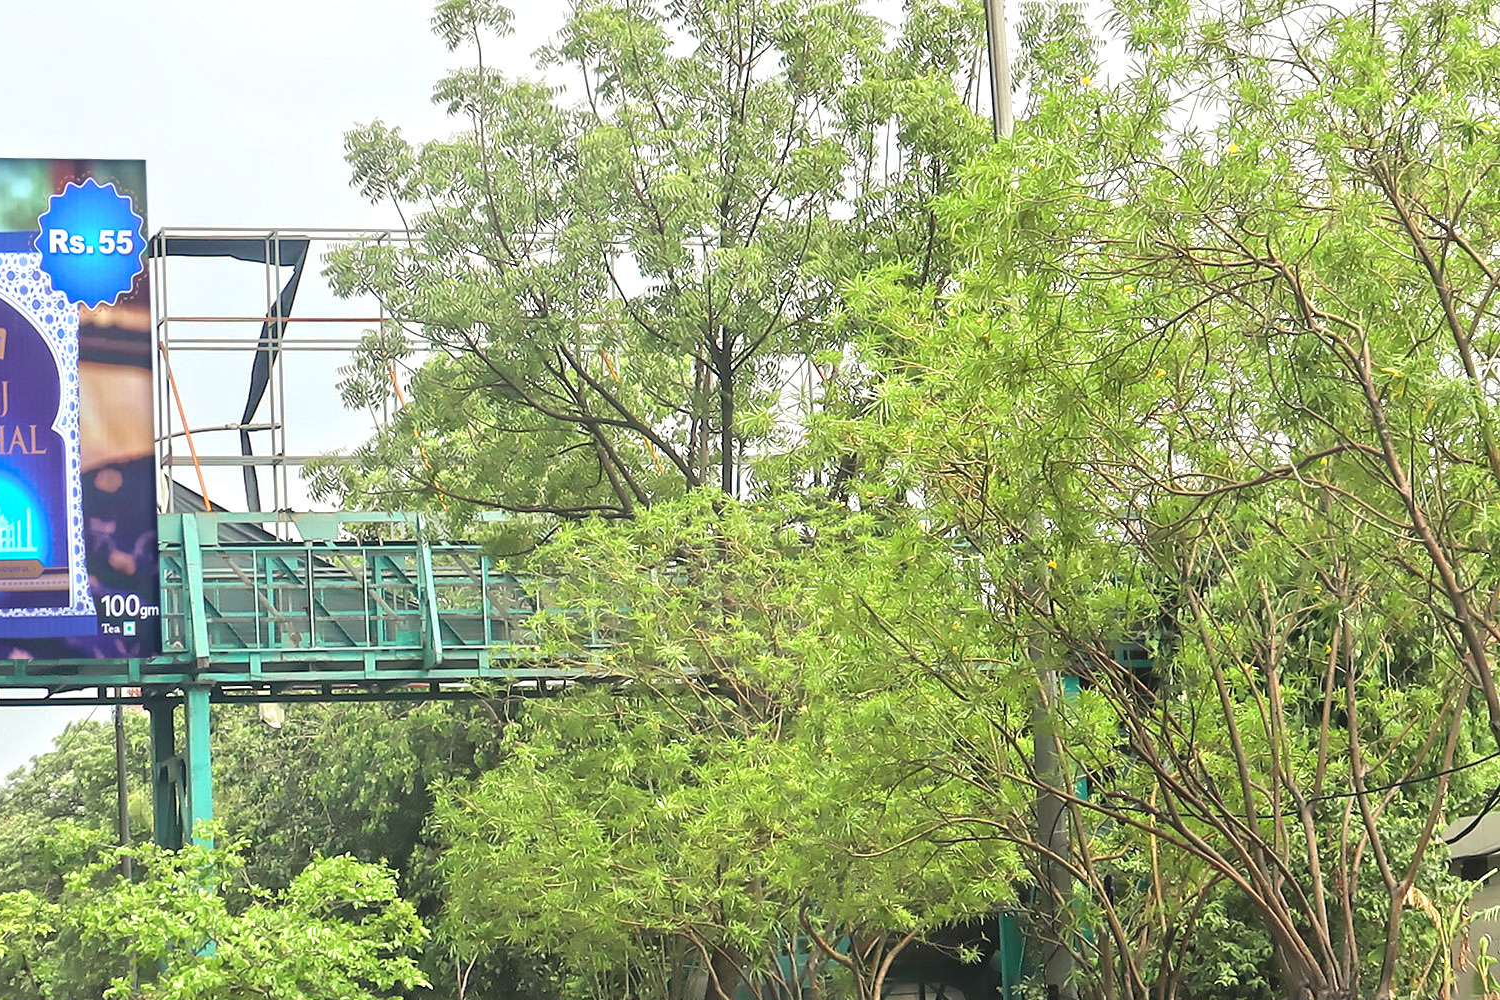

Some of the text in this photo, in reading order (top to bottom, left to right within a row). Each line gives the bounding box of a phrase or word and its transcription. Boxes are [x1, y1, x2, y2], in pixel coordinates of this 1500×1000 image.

[49, 229, 134, 255] Rs. 55
[100, 594, 160, 620] 100gm
[101, 622, 121, 634] Tea
